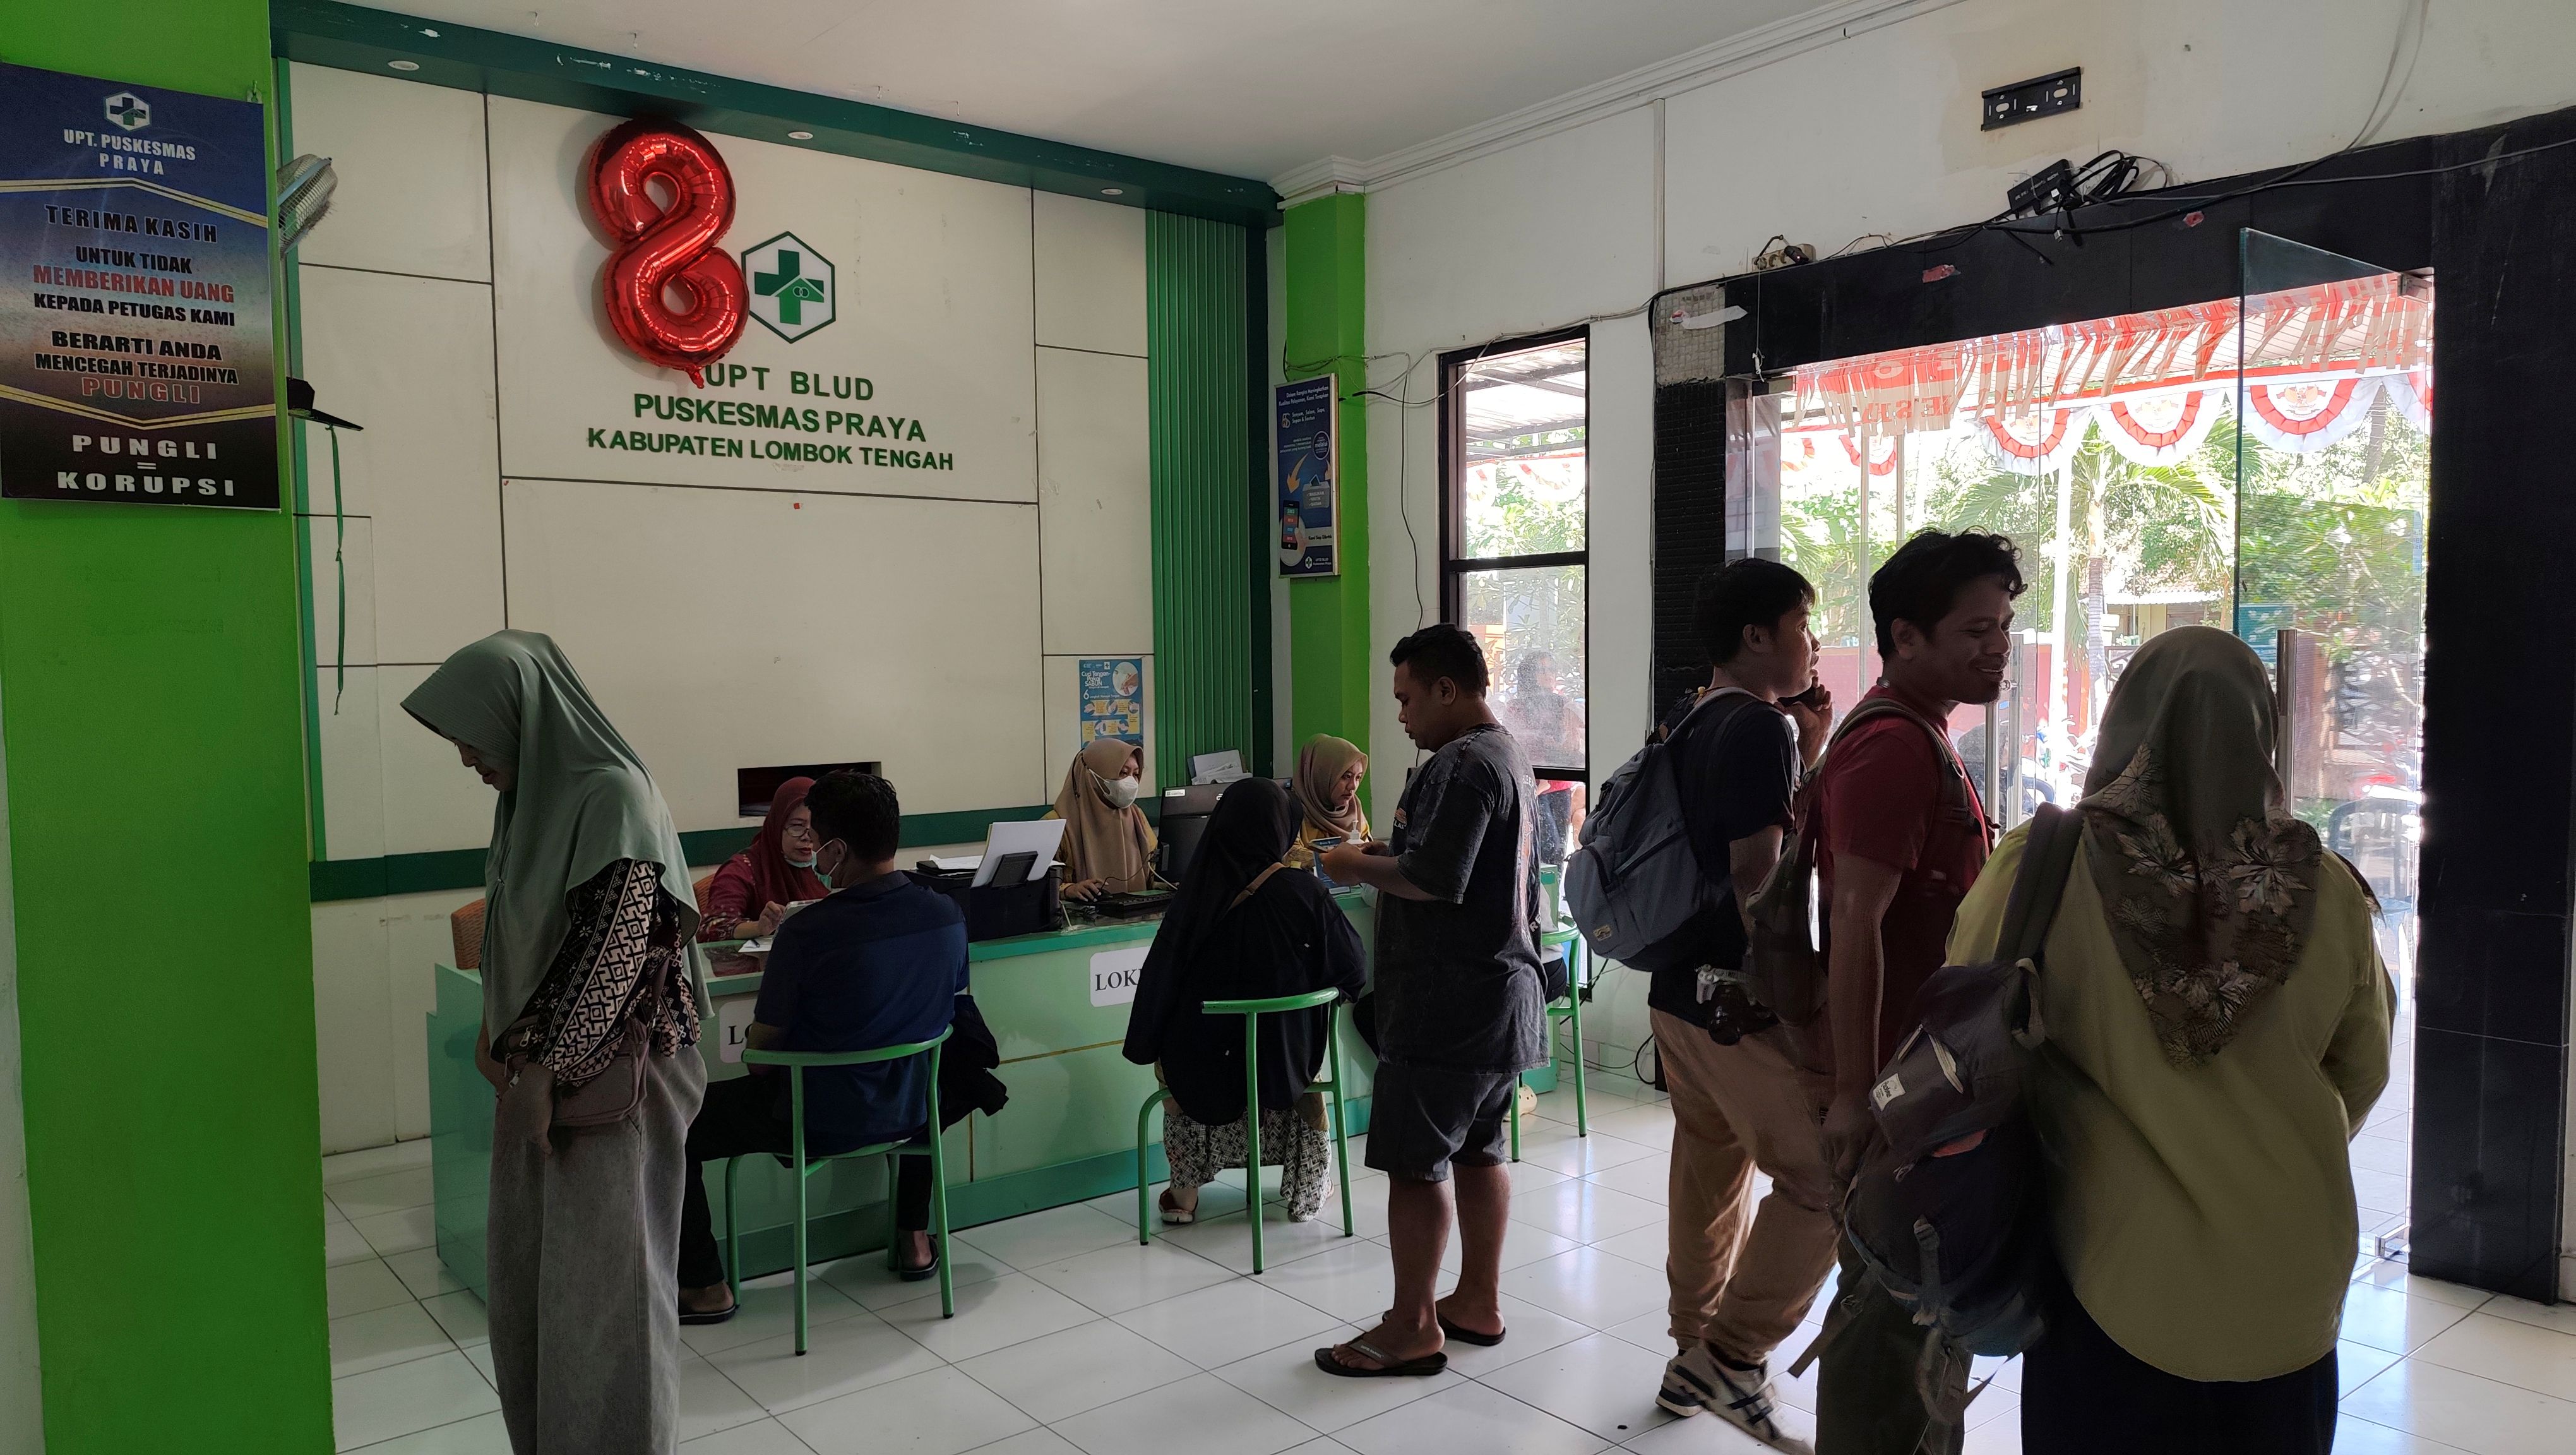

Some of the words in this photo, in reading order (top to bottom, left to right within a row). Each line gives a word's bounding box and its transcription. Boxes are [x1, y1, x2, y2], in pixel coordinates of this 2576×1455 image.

[64, 129, 97, 147] UPT.
[101, 134, 196, 161] PUSKESMAS
[100, 153, 164, 175] PRAYA
[45, 205, 140, 234] TERIMA
[146, 219, 217, 242] KASIH
[76, 246, 136, 267] UNTUK
[141, 253, 191, 274] TIDAK
[33, 265, 174, 297] MEMBERIKAN
[180, 280, 234, 302] UANG
[34, 293, 104, 314] KEPADA
[109, 301, 186, 321] PETUGAS
[191, 308, 235, 326] KAMI
[52, 331, 153, 355] BERARTI
[159, 340, 222, 361] ANDA
[35, 355, 133, 376] MENCEGAH
[136, 363, 238, 385] TERJADINYA
[705, 364, 770, 390] UPT
[791, 371, 873, 400] BLUD
[83, 378, 200, 404] PUNGLI
[635, 394, 820, 433] PUSKESMAS
[826, 411, 926, 442] PRAYA
[73, 434, 217, 459] PUNGLI
[588, 428, 742, 458] KABUPATEN
[751, 440, 852, 464] LOMBOK
[859, 448, 953, 470] TENGAH
[57, 471, 234, 496] KORUPSI
[1083, 689, 1089, 700] 6
